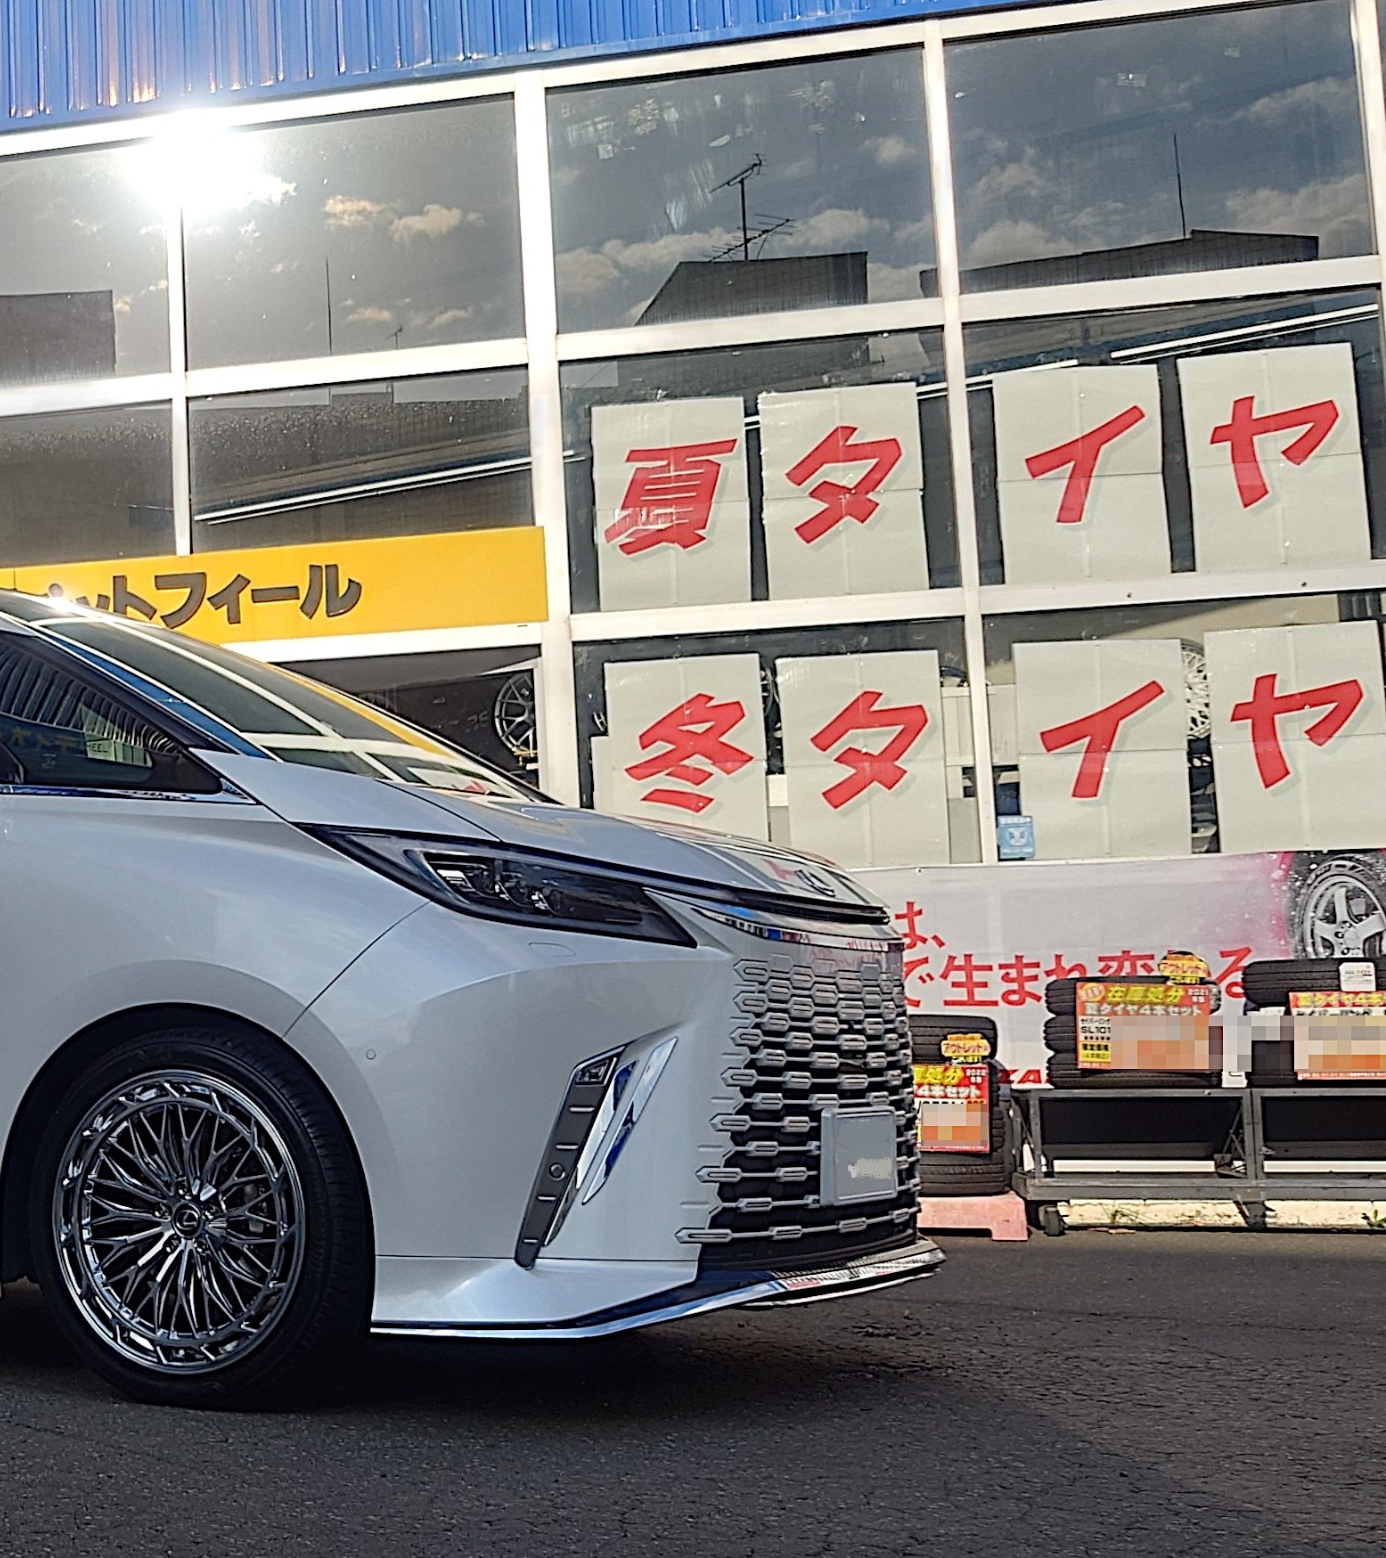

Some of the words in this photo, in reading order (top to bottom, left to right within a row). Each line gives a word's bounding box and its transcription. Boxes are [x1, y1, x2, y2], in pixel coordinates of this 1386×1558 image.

[605, 395, 1340, 556] 夏タイヤ
[48, 564, 362, 629] トフィール
[625, 673, 1365, 814] 冬タイヤ
[904, 946, 1252, 1008] で生まれ変る
[1108, 986, 1185, 1003] 在庫処分
